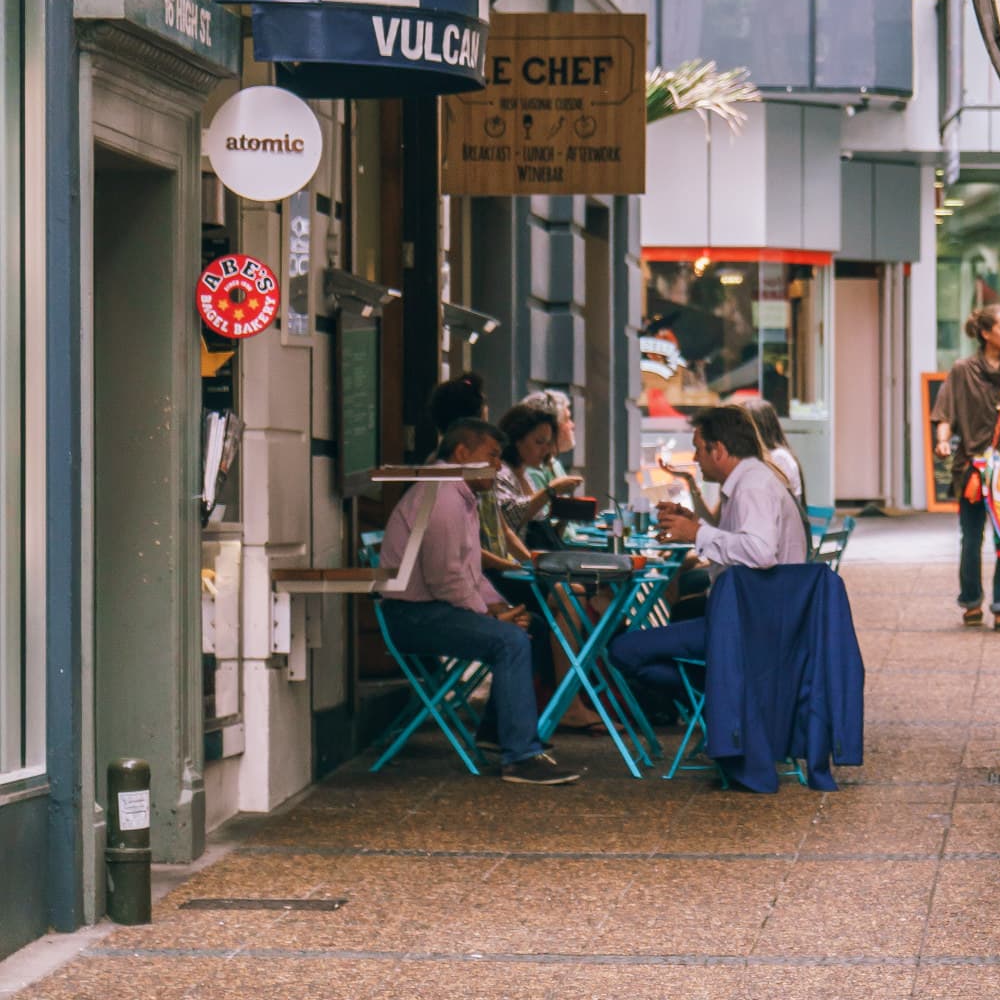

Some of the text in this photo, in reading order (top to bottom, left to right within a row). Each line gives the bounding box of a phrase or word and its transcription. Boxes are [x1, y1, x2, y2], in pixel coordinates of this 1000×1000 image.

[372, 15, 480, 69] VULCAN
[522, 56, 613, 85] CHEF
[226, 133, 304, 153] atomic
[202, 257, 275, 294] ABE'S
[200, 294, 276, 335] BAGEL BAKERY
